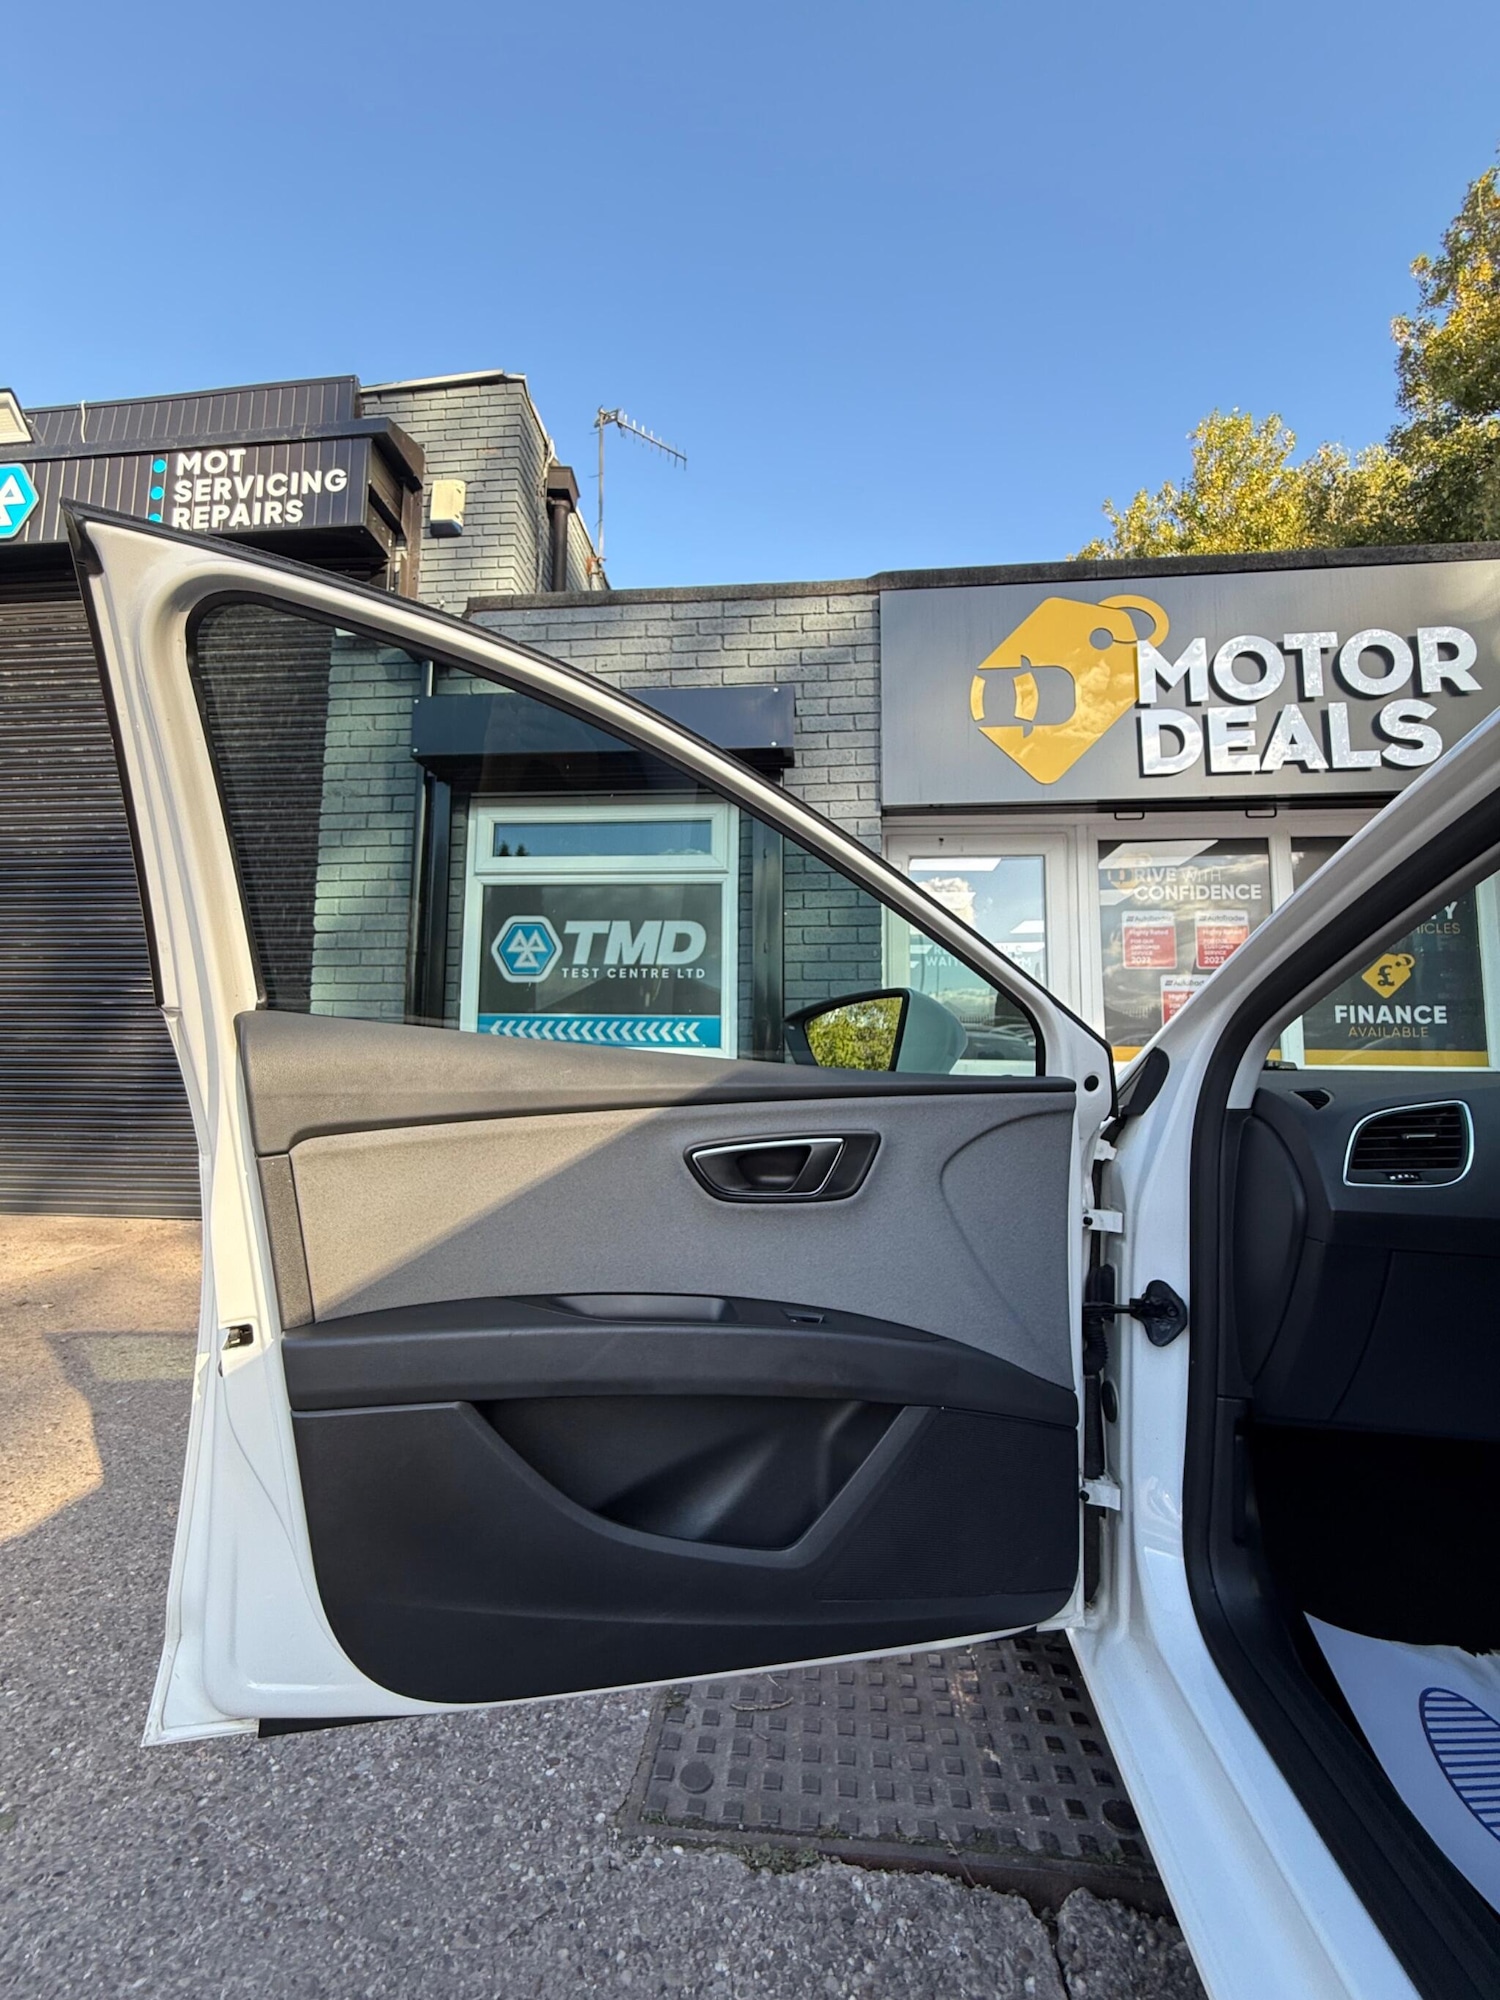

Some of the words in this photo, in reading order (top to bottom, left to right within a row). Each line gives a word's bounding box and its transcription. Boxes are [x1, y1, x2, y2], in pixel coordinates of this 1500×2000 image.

[177, 448, 246, 476] MOT
[174, 469, 347, 503] SERVICING
[172, 499, 304, 530] REPAIRS
[1137, 626, 1482, 704] MOTOR
[1140, 699, 1443, 775] DEALS
[1182, 866, 1222, 882] WITH
[1133, 884, 1262, 900] CONFIDENCE
[563, 920, 707, 965] TMD
[562, 968, 600, 979] TEST
[607, 968, 670, 979] CENTRE
[677, 968, 706, 979] LTD
[1334, 1005, 1448, 1024] FINANCE
[1348, 1026, 1429, 1038] AVAILABLE
